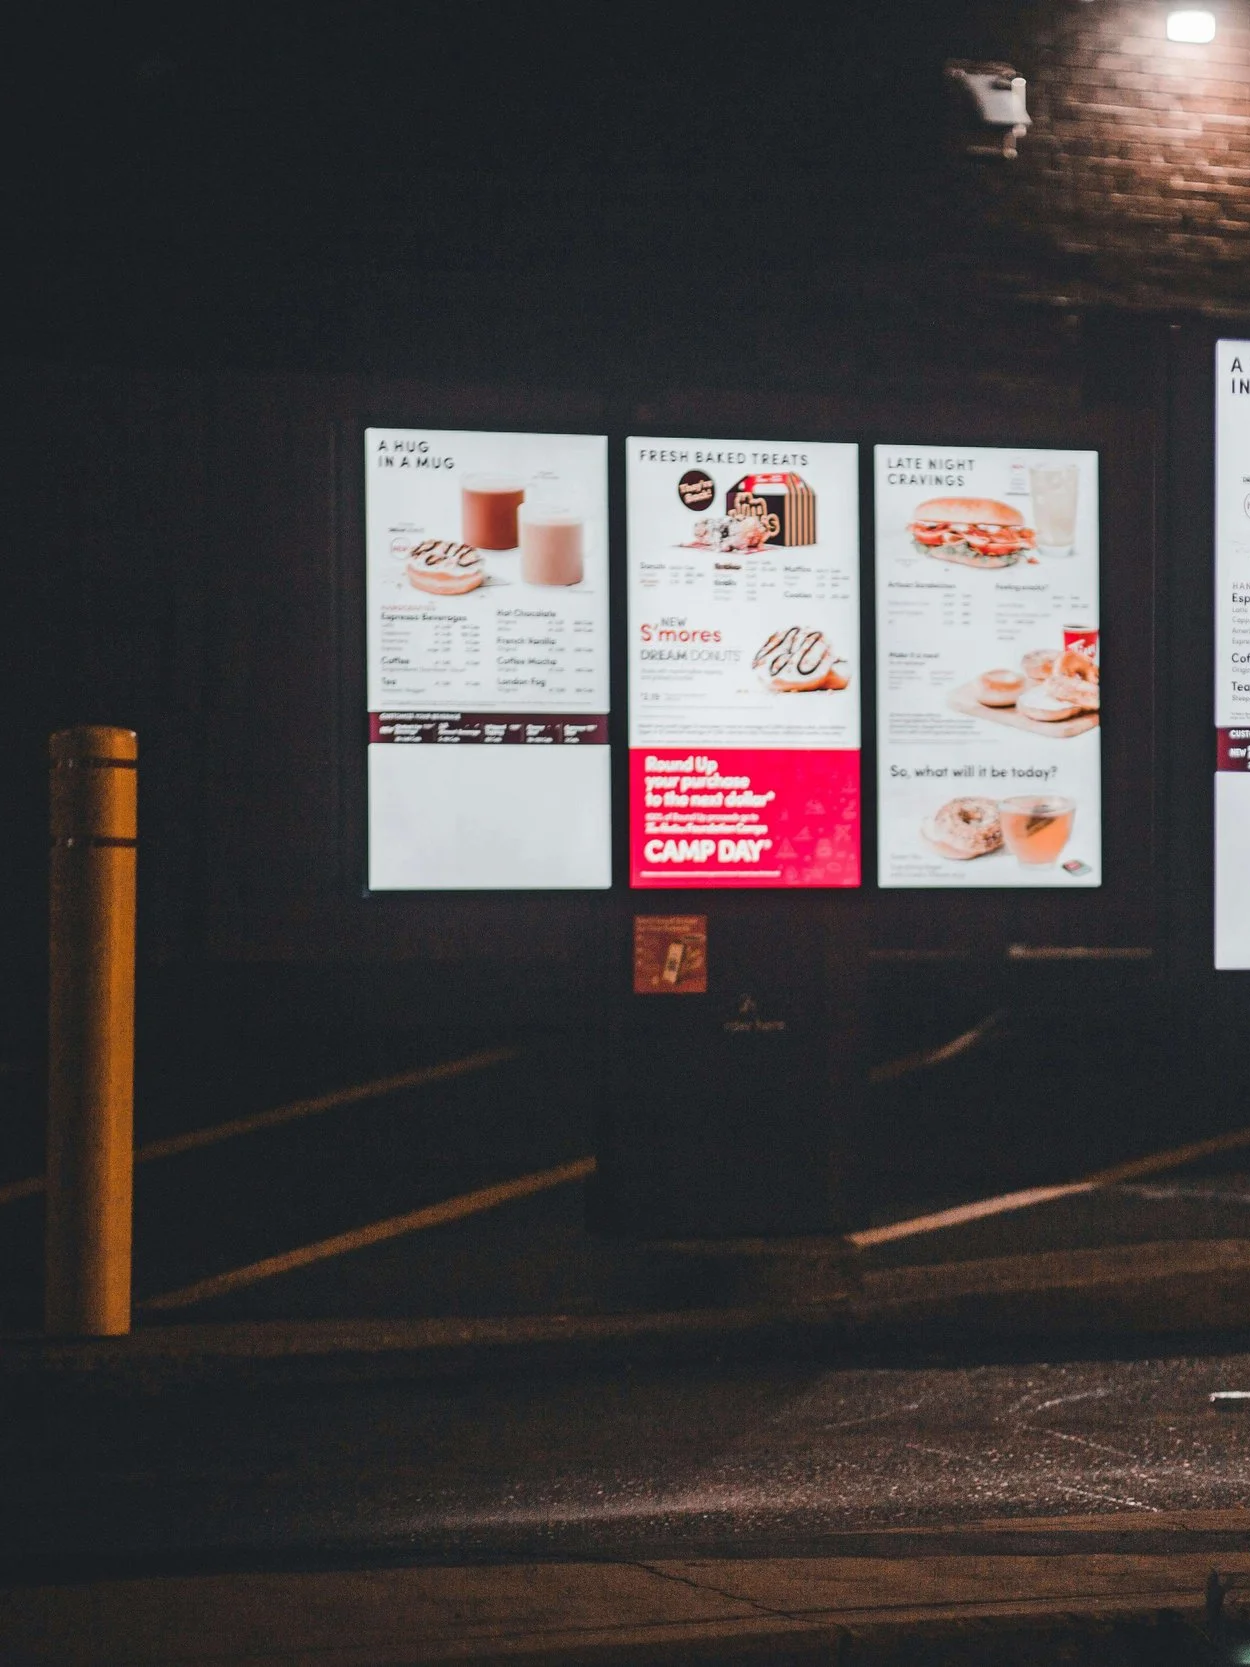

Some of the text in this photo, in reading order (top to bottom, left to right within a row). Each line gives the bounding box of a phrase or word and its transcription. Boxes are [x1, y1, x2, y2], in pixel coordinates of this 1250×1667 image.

[1231, 357, 1243, 373] A
[1231, 378, 1250, 394] IN
[378, 441, 430, 452] A HUG
[378, 456, 455, 469] IN A MUG
[640, 451, 808, 466] FRESH BAKED TREATS
[888, 458, 974, 471] LATE NIGHT
[888, 473, 965, 486] CRAVINGS
[661, 618, 686, 627] NEW
[641, 623, 721, 643] S'mores
[641, 650, 687, 661] DREAM
[1231, 681, 1250, 691] Tea
[1229, 748, 1246, 758] NEW
[645, 756, 718, 776] Round Up
[890, 765, 1057, 781] So, what will it be today?
[645, 773, 750, 791] your purchase
[645, 792, 662, 807] to
[663, 791, 688, 807] the
[690, 792, 724, 807] next
[644, 840, 716, 862] CAMP
